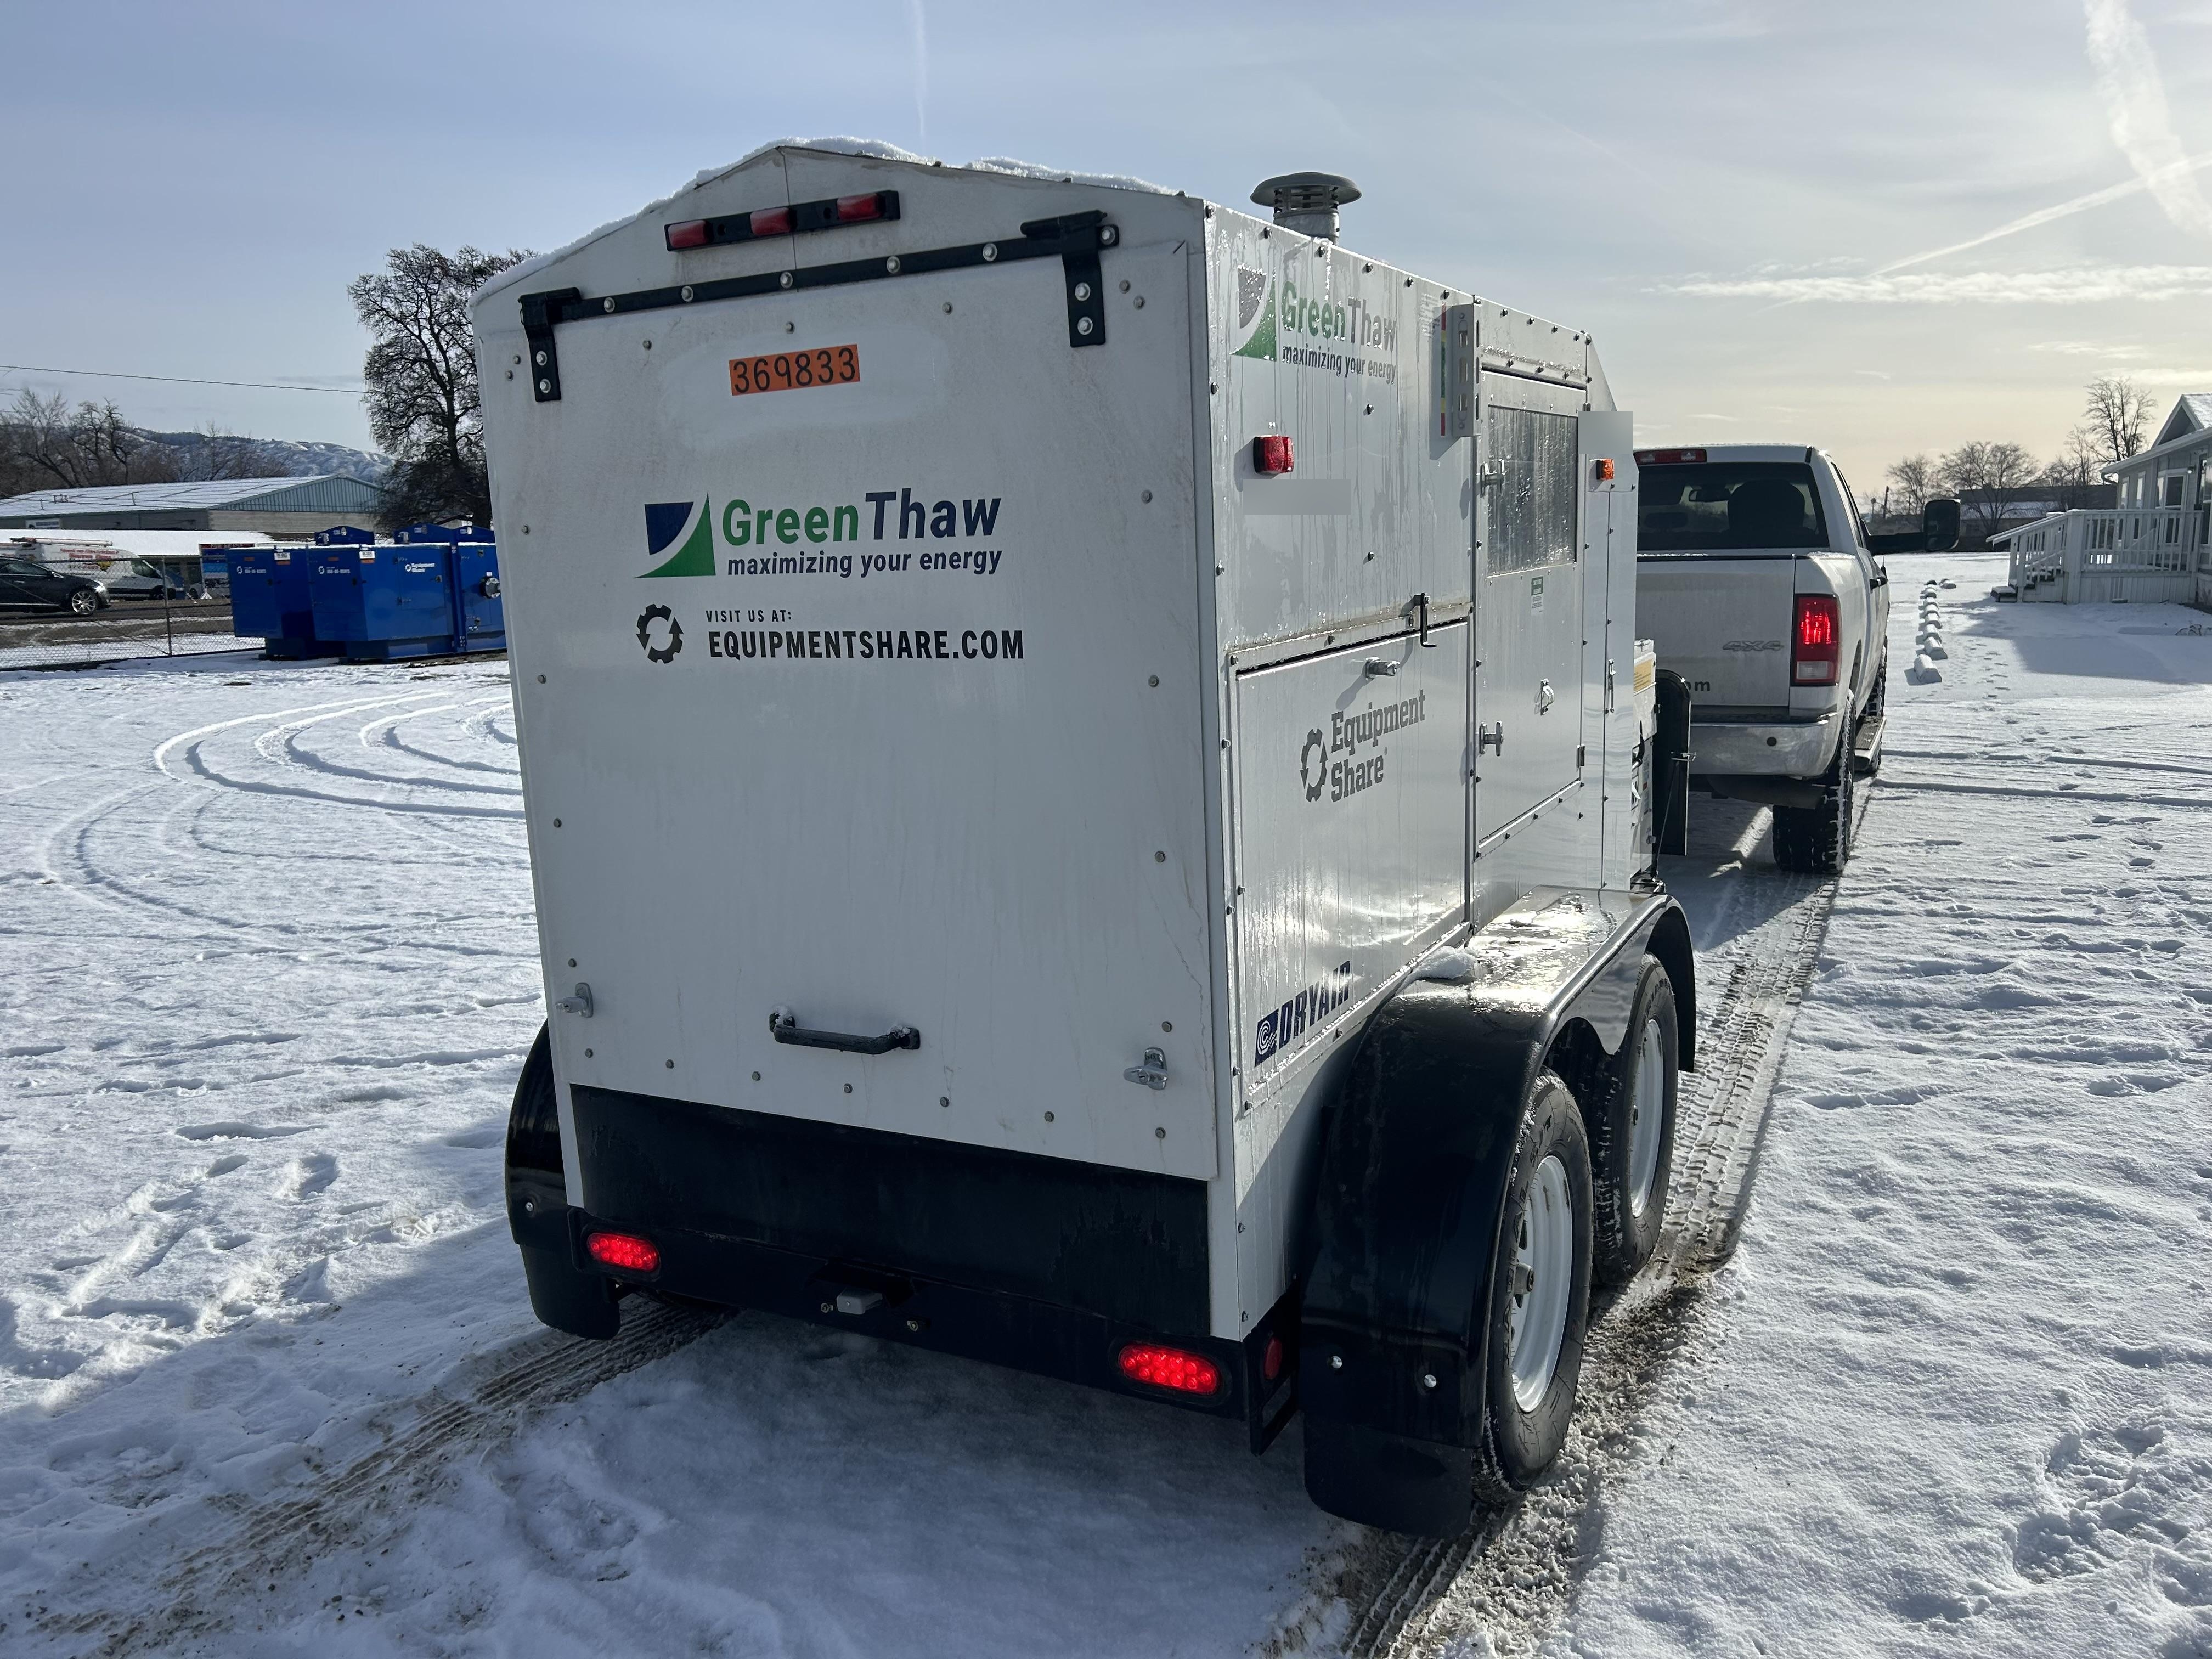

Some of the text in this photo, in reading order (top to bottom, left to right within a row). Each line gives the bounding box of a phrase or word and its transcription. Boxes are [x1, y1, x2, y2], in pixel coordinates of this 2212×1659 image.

[1281, 281, 1397, 352] GreenThaw
[733, 347, 856, 393] 369833
[1283, 343, 1396, 385] maximizing your energy
[723, 488, 1001, 545] GreenThaw
[728, 550, 1002, 578] maximizing your energy
[706, 609, 792, 623] VISIT US AT:
[708, 630, 1024, 660] EQUIPMENTSHARE.COM
[1331, 689, 1425, 756] Equipment
[1279, 961, 1350, 1049] DRYAIR
